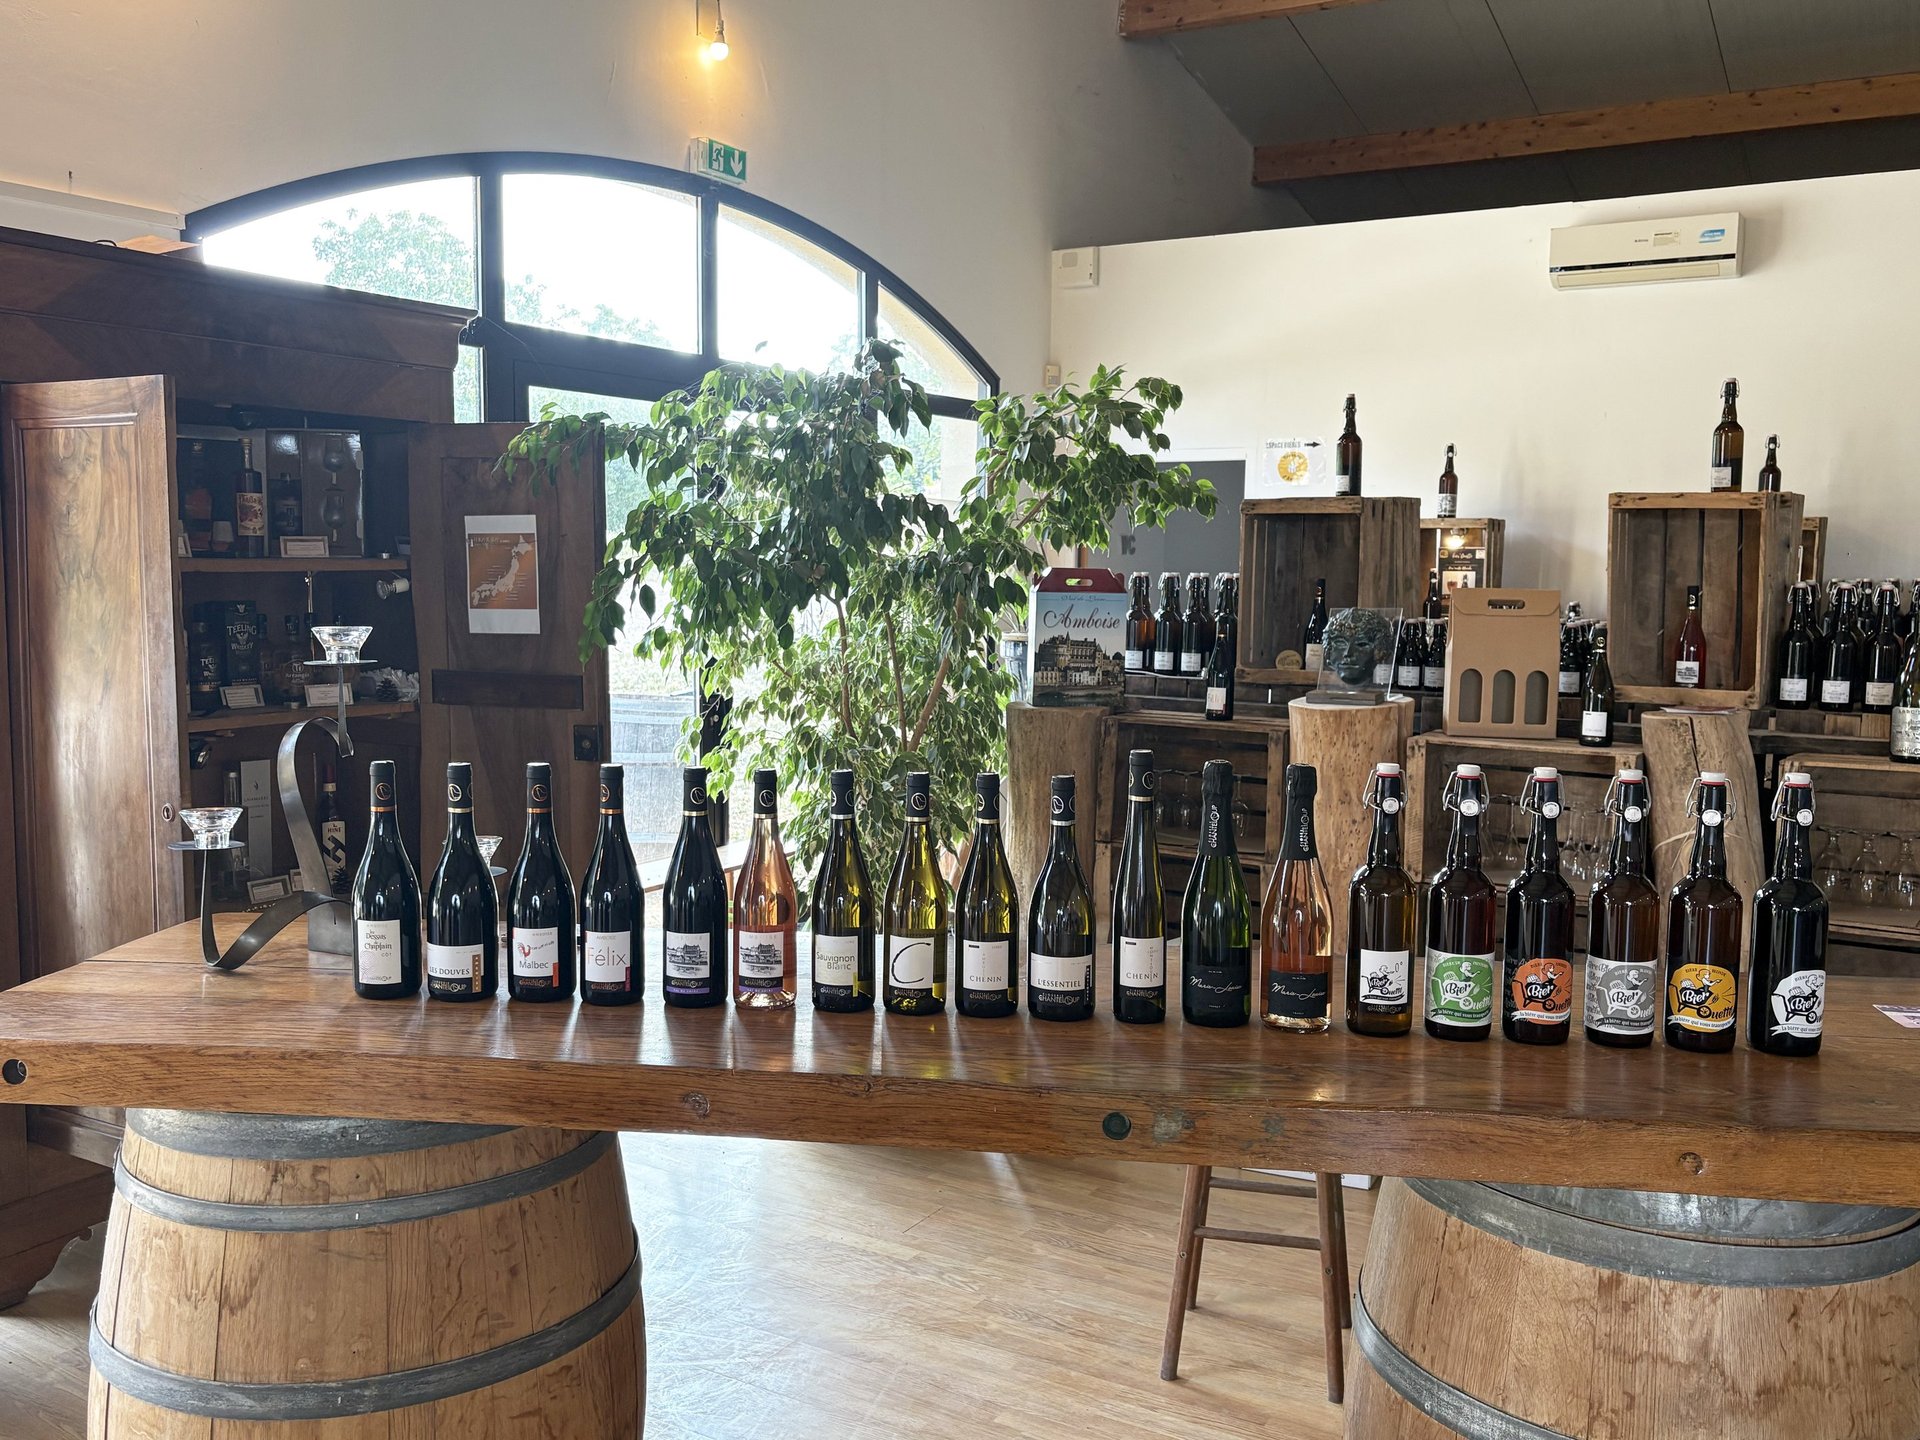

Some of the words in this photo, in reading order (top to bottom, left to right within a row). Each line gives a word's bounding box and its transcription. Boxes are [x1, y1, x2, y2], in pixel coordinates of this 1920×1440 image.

[1043, 604, 1121, 629] Amboise
[227, 624, 257, 636] TEELING
[586, 947, 627, 967] Félix
[816, 951, 855, 964] Sauvignon
[519, 960, 549, 969] Malbec
[827, 962, 851, 970] Blanc
[891, 942, 931, 984] C
[429, 966, 438, 974] LES
[439, 968, 470, 976] DOUVES
[1126, 972, 1158, 980] CHENIN
[969, 975, 1002, 983] CHENIN
[1038, 978, 1081, 988] L'ESSENTIEL
